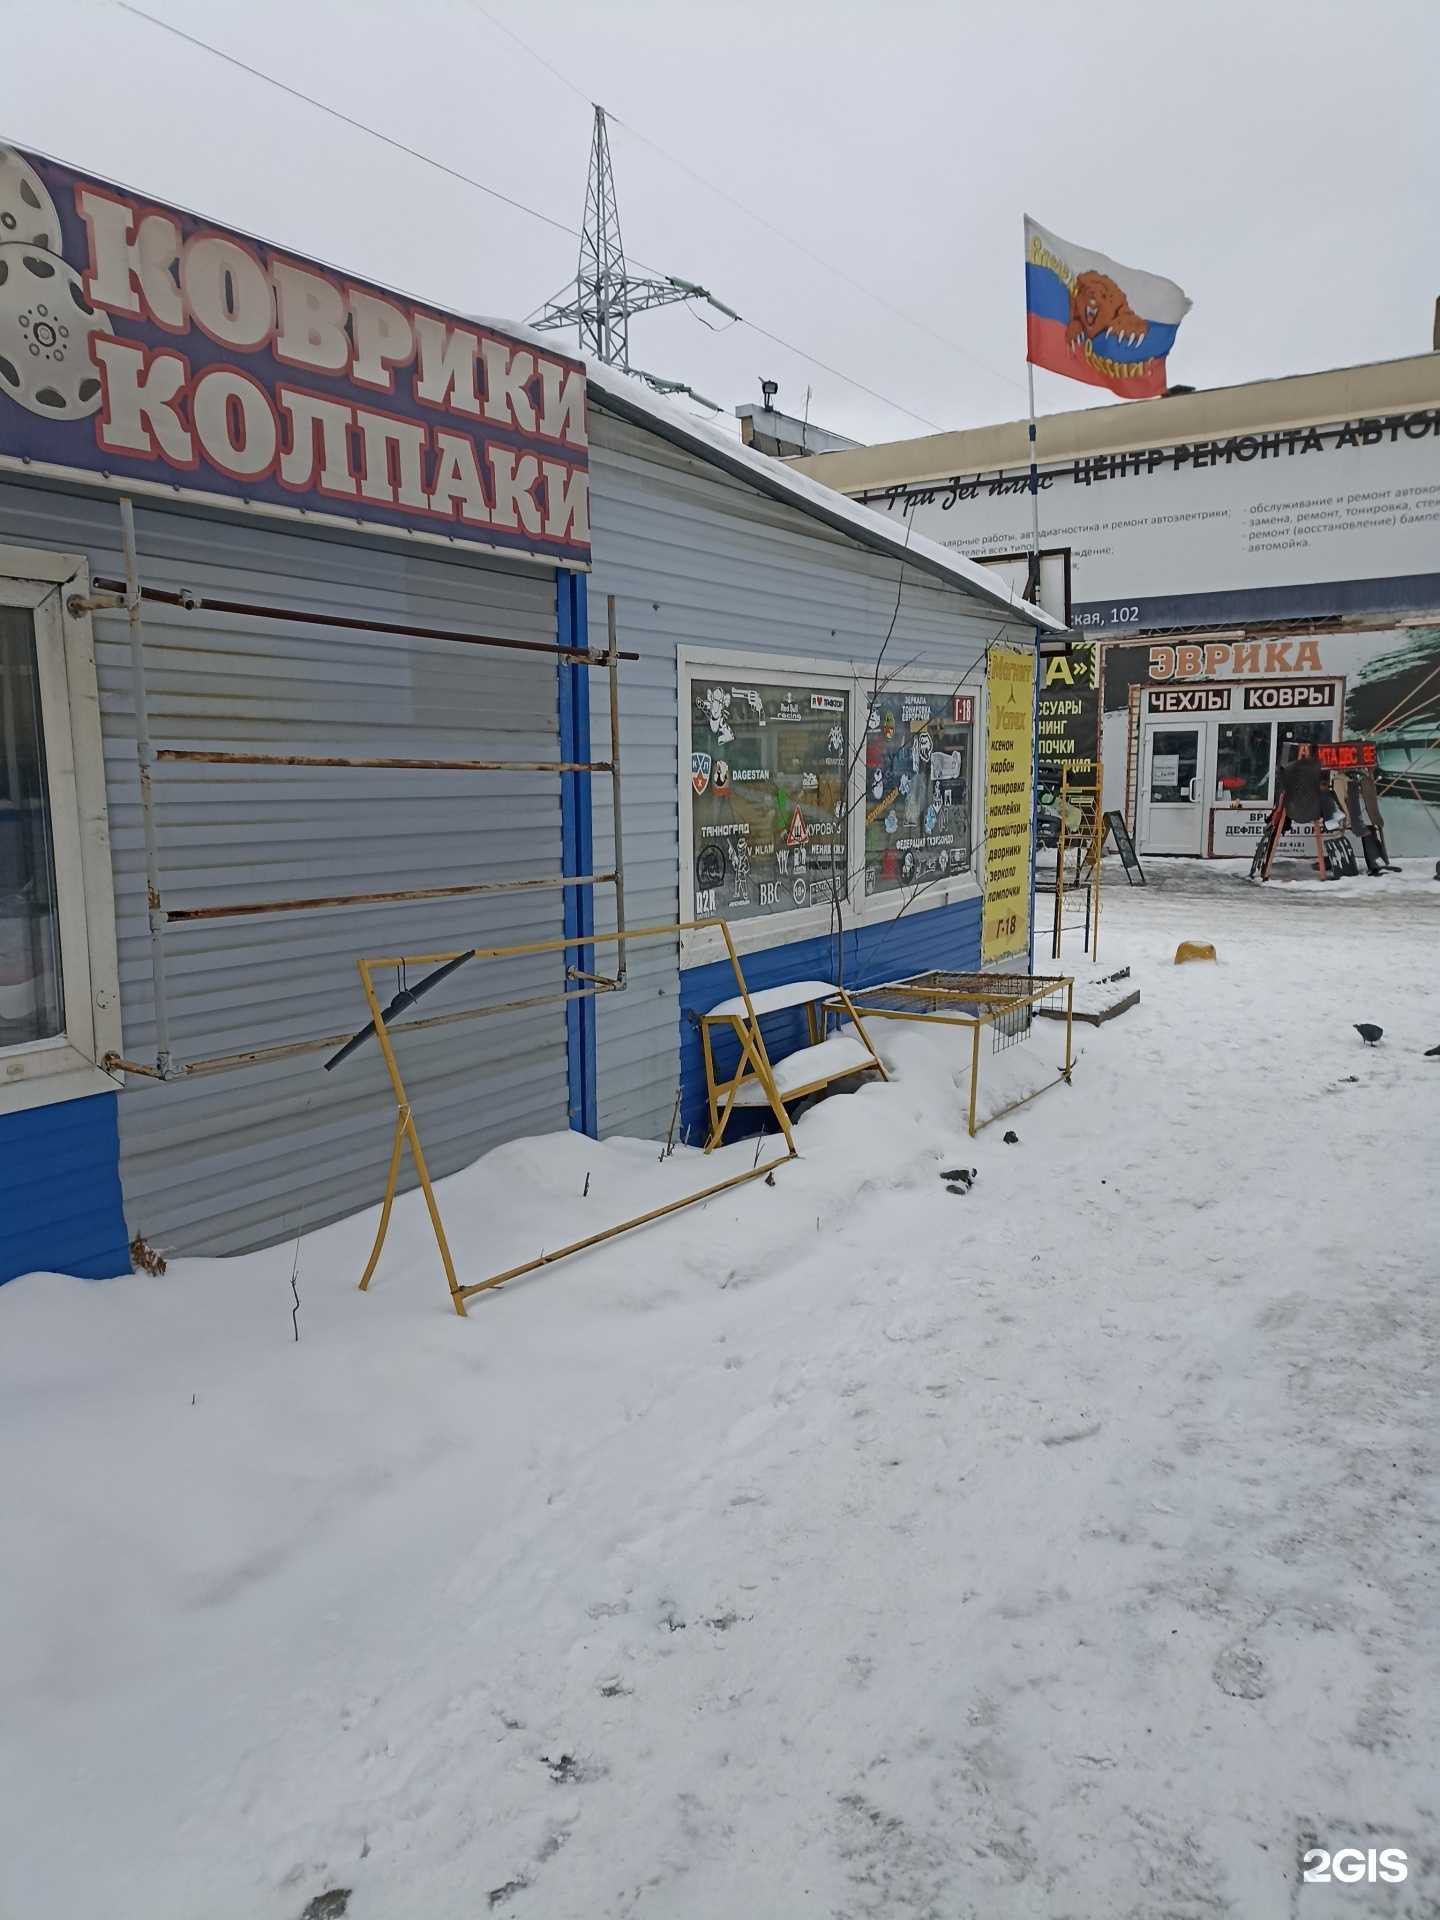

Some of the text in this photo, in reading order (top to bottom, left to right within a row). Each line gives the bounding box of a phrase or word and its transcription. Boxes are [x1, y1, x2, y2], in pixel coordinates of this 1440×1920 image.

[76, 185, 587, 448] КОВРИКИ
[90, 330, 591, 547] КОЛПАКИ
[1074, 452, 1163, 486] ЦЕНТР
[1174, 428, 1324, 471] РЕМОНТА
[1250, 497, 1334, 515] обслуживание
[1347, 490, 1391, 505] ремонт
[1297, 509, 1342, 524] ремонт,
[1346, 503, 1412, 518] тонировка,
[1111, 518, 1150, 533] ремонт
[1248, 528, 1290, 542] ремонт
[1293, 516, 1396, 537] (восстановление)
[1111, 606, 1139, 623] 102
[1148, 640, 1322, 679] ЭВРИКА
[1151, 690, 1229, 711] ЧЕХЛЫ
[1249, 686, 1330, 707] КОВРЫ
[990, 740, 1014, 751] ксенон
[732, 769, 770, 781] DAGESTAN
[990, 758, 1015, 776] карбон
[989, 781, 1025, 797] тонировка
[989, 801, 1021, 817] наклейки
[988, 823, 1029, 840] автошторки
[987, 845, 1022, 863] дворники
[989, 866, 1017, 883] зеркало
[987, 886, 1021, 903] лампочки
